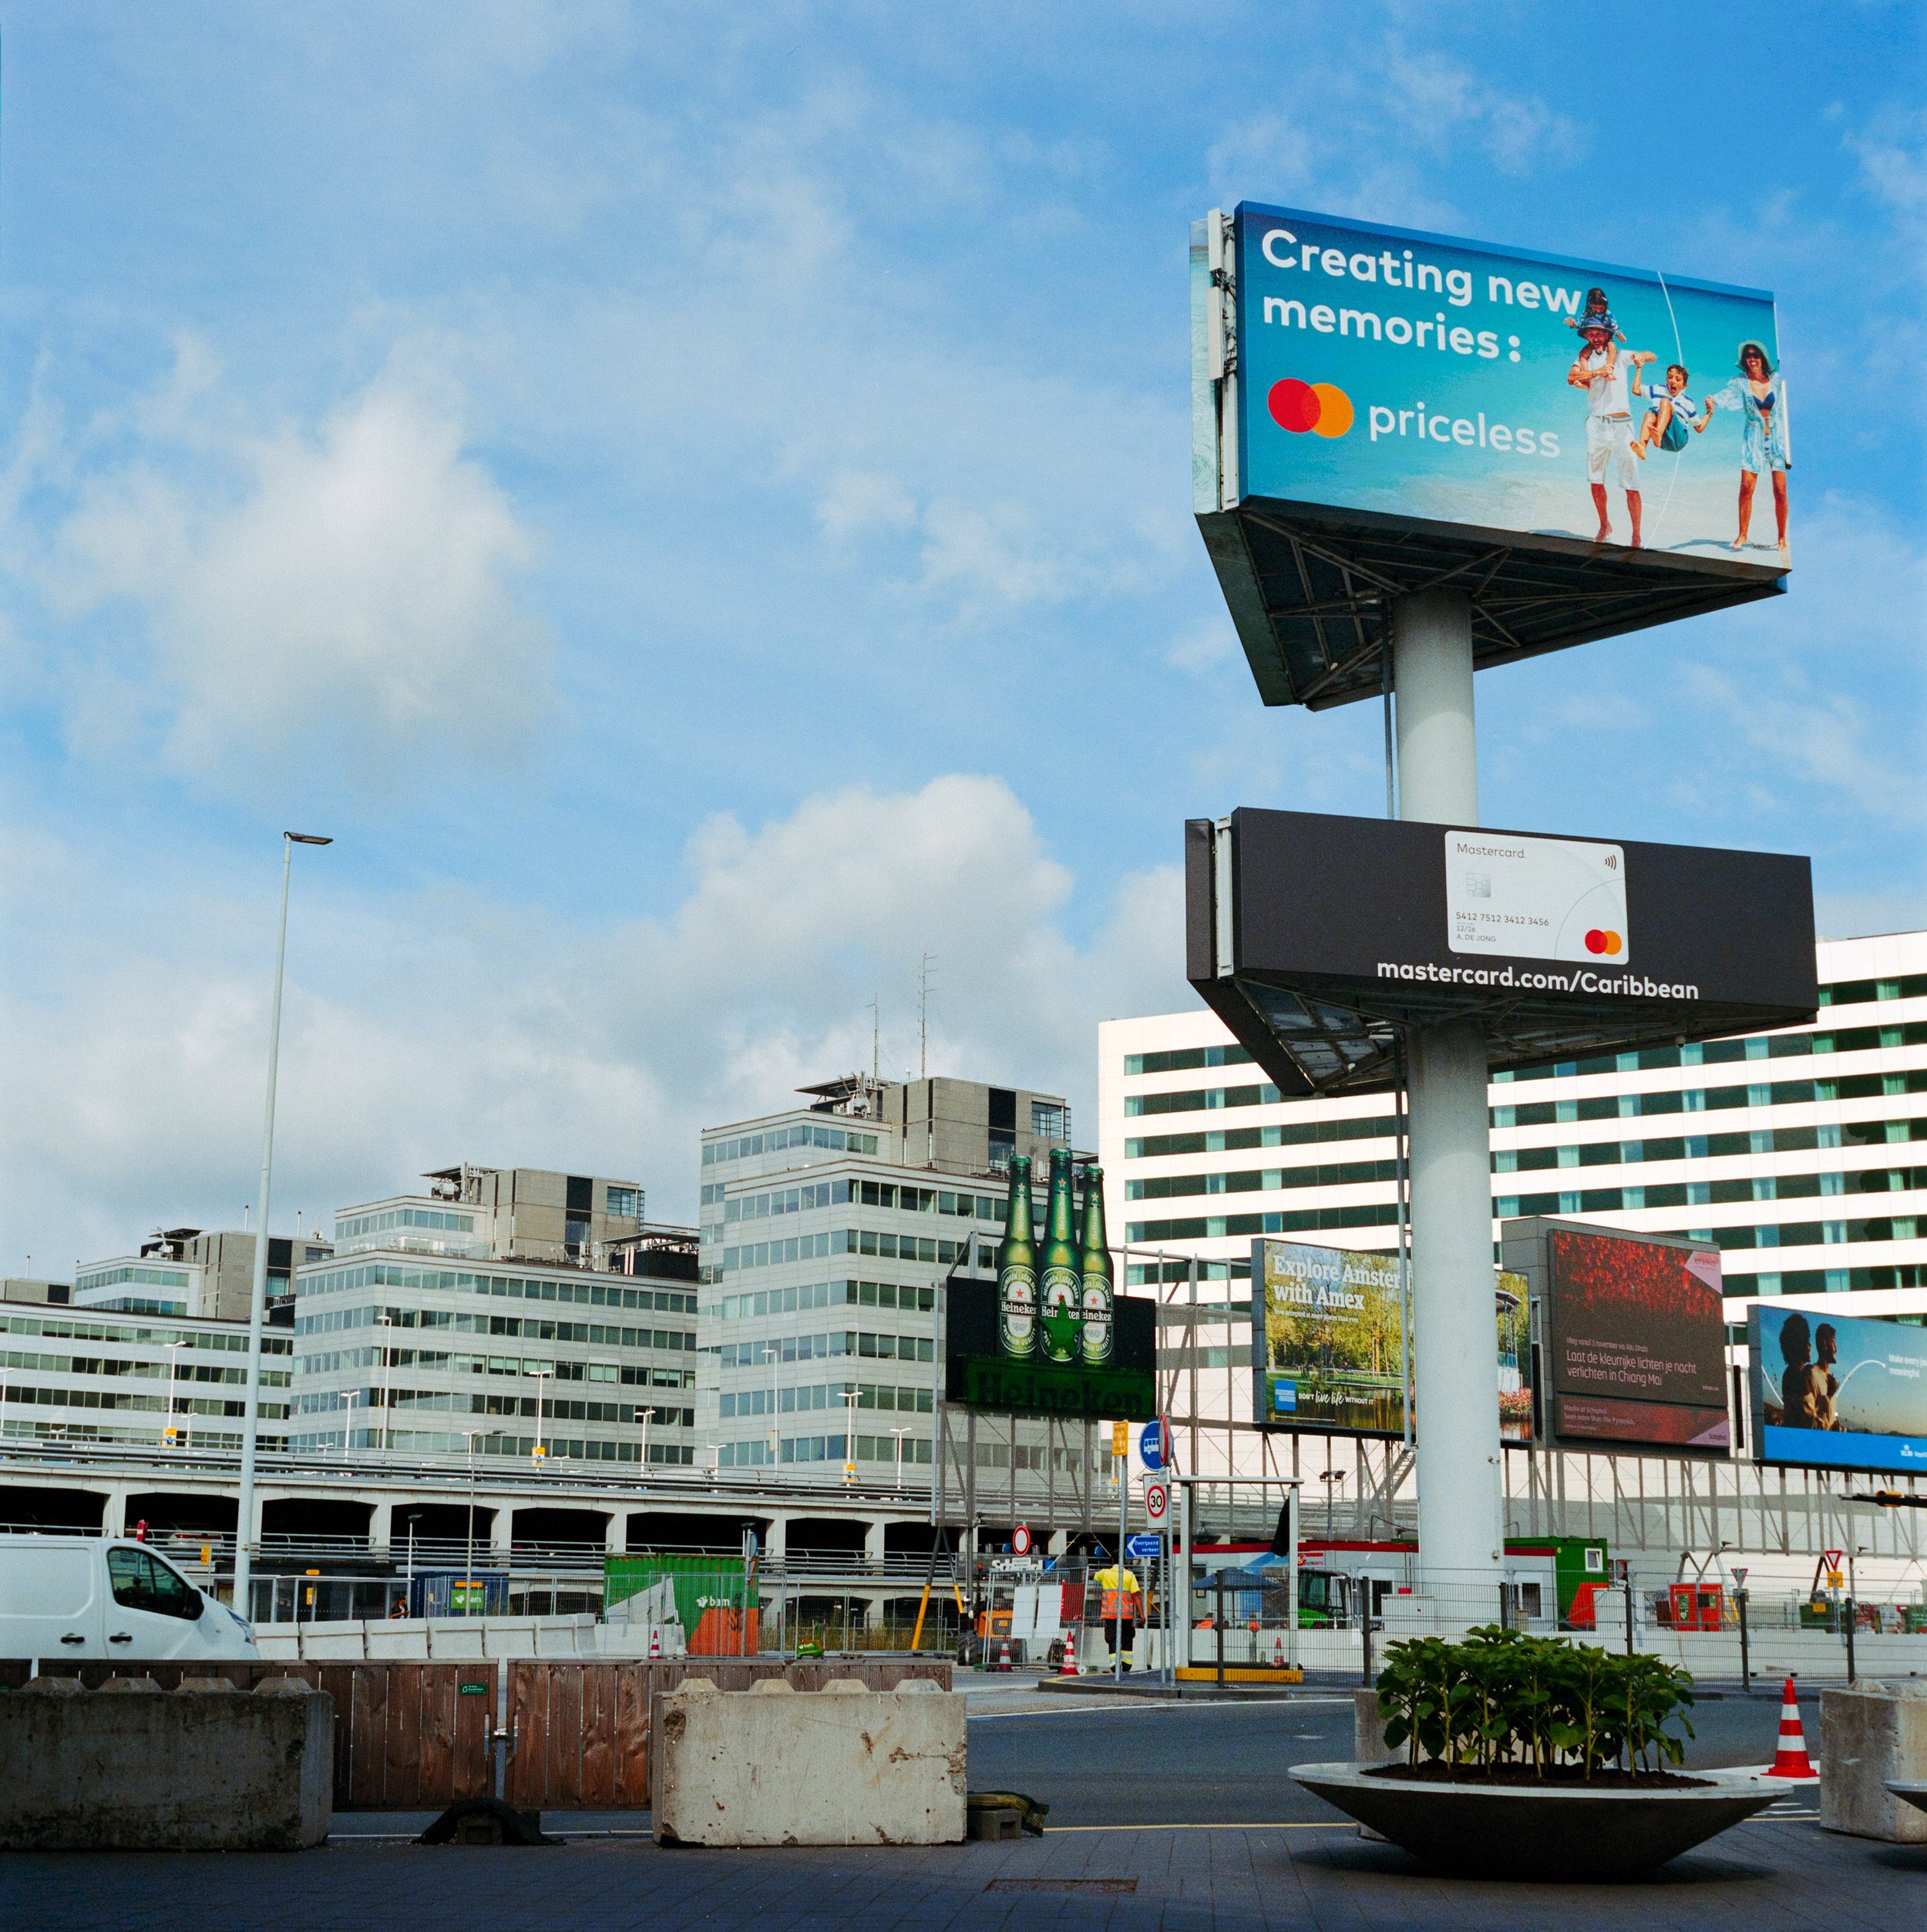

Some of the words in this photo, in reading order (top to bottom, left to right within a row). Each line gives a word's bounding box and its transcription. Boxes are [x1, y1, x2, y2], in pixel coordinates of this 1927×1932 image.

[1262, 229, 1472, 306] Creating
[1489, 274, 1582, 314] new
[1370, 402, 1561, 457] priceless
[1457, 843, 1525, 858] Mastercard
[1456, 912, 1478, 921] 5412
[1481, 913, 1502, 922] 7512
[1504, 916, 1525, 924] 3412
[1528, 917, 1549, 926] 3456
[1377, 962, 1699, 1000] mastercard.com/Caribbean
[1273, 1255, 1339, 1282] Explore
[1273, 1282, 1313, 1305] with
[1317, 1286, 1365, 1310] Amex
[1082, 1309, 1112, 1322] eineken
[1566, 1349, 1585, 1362] Laat
[1587, 1351, 1598, 1363] de
[1599, 1352, 1636, 1369] kleurrijke
[1638, 1356, 1663, 1369] lichten
[1665, 1362, 1673, 1374] je
[1674, 1362, 1697, 1374] nacht
[1567, 1366, 1608, 1380] verlichten
[1609, 1370, 1617, 1381] in
[1619, 1369, 1646, 1386] Chiang
[1648, 1374, 1663, 1386] Mai
[977, 1372, 1142, 1413] Heineken
[1315, 1390, 1330, 1403] live
[1331, 1391, 1345, 1406] life
[1150, 1495, 1162, 1507] 30
[710, 1595, 730, 1607] bam
